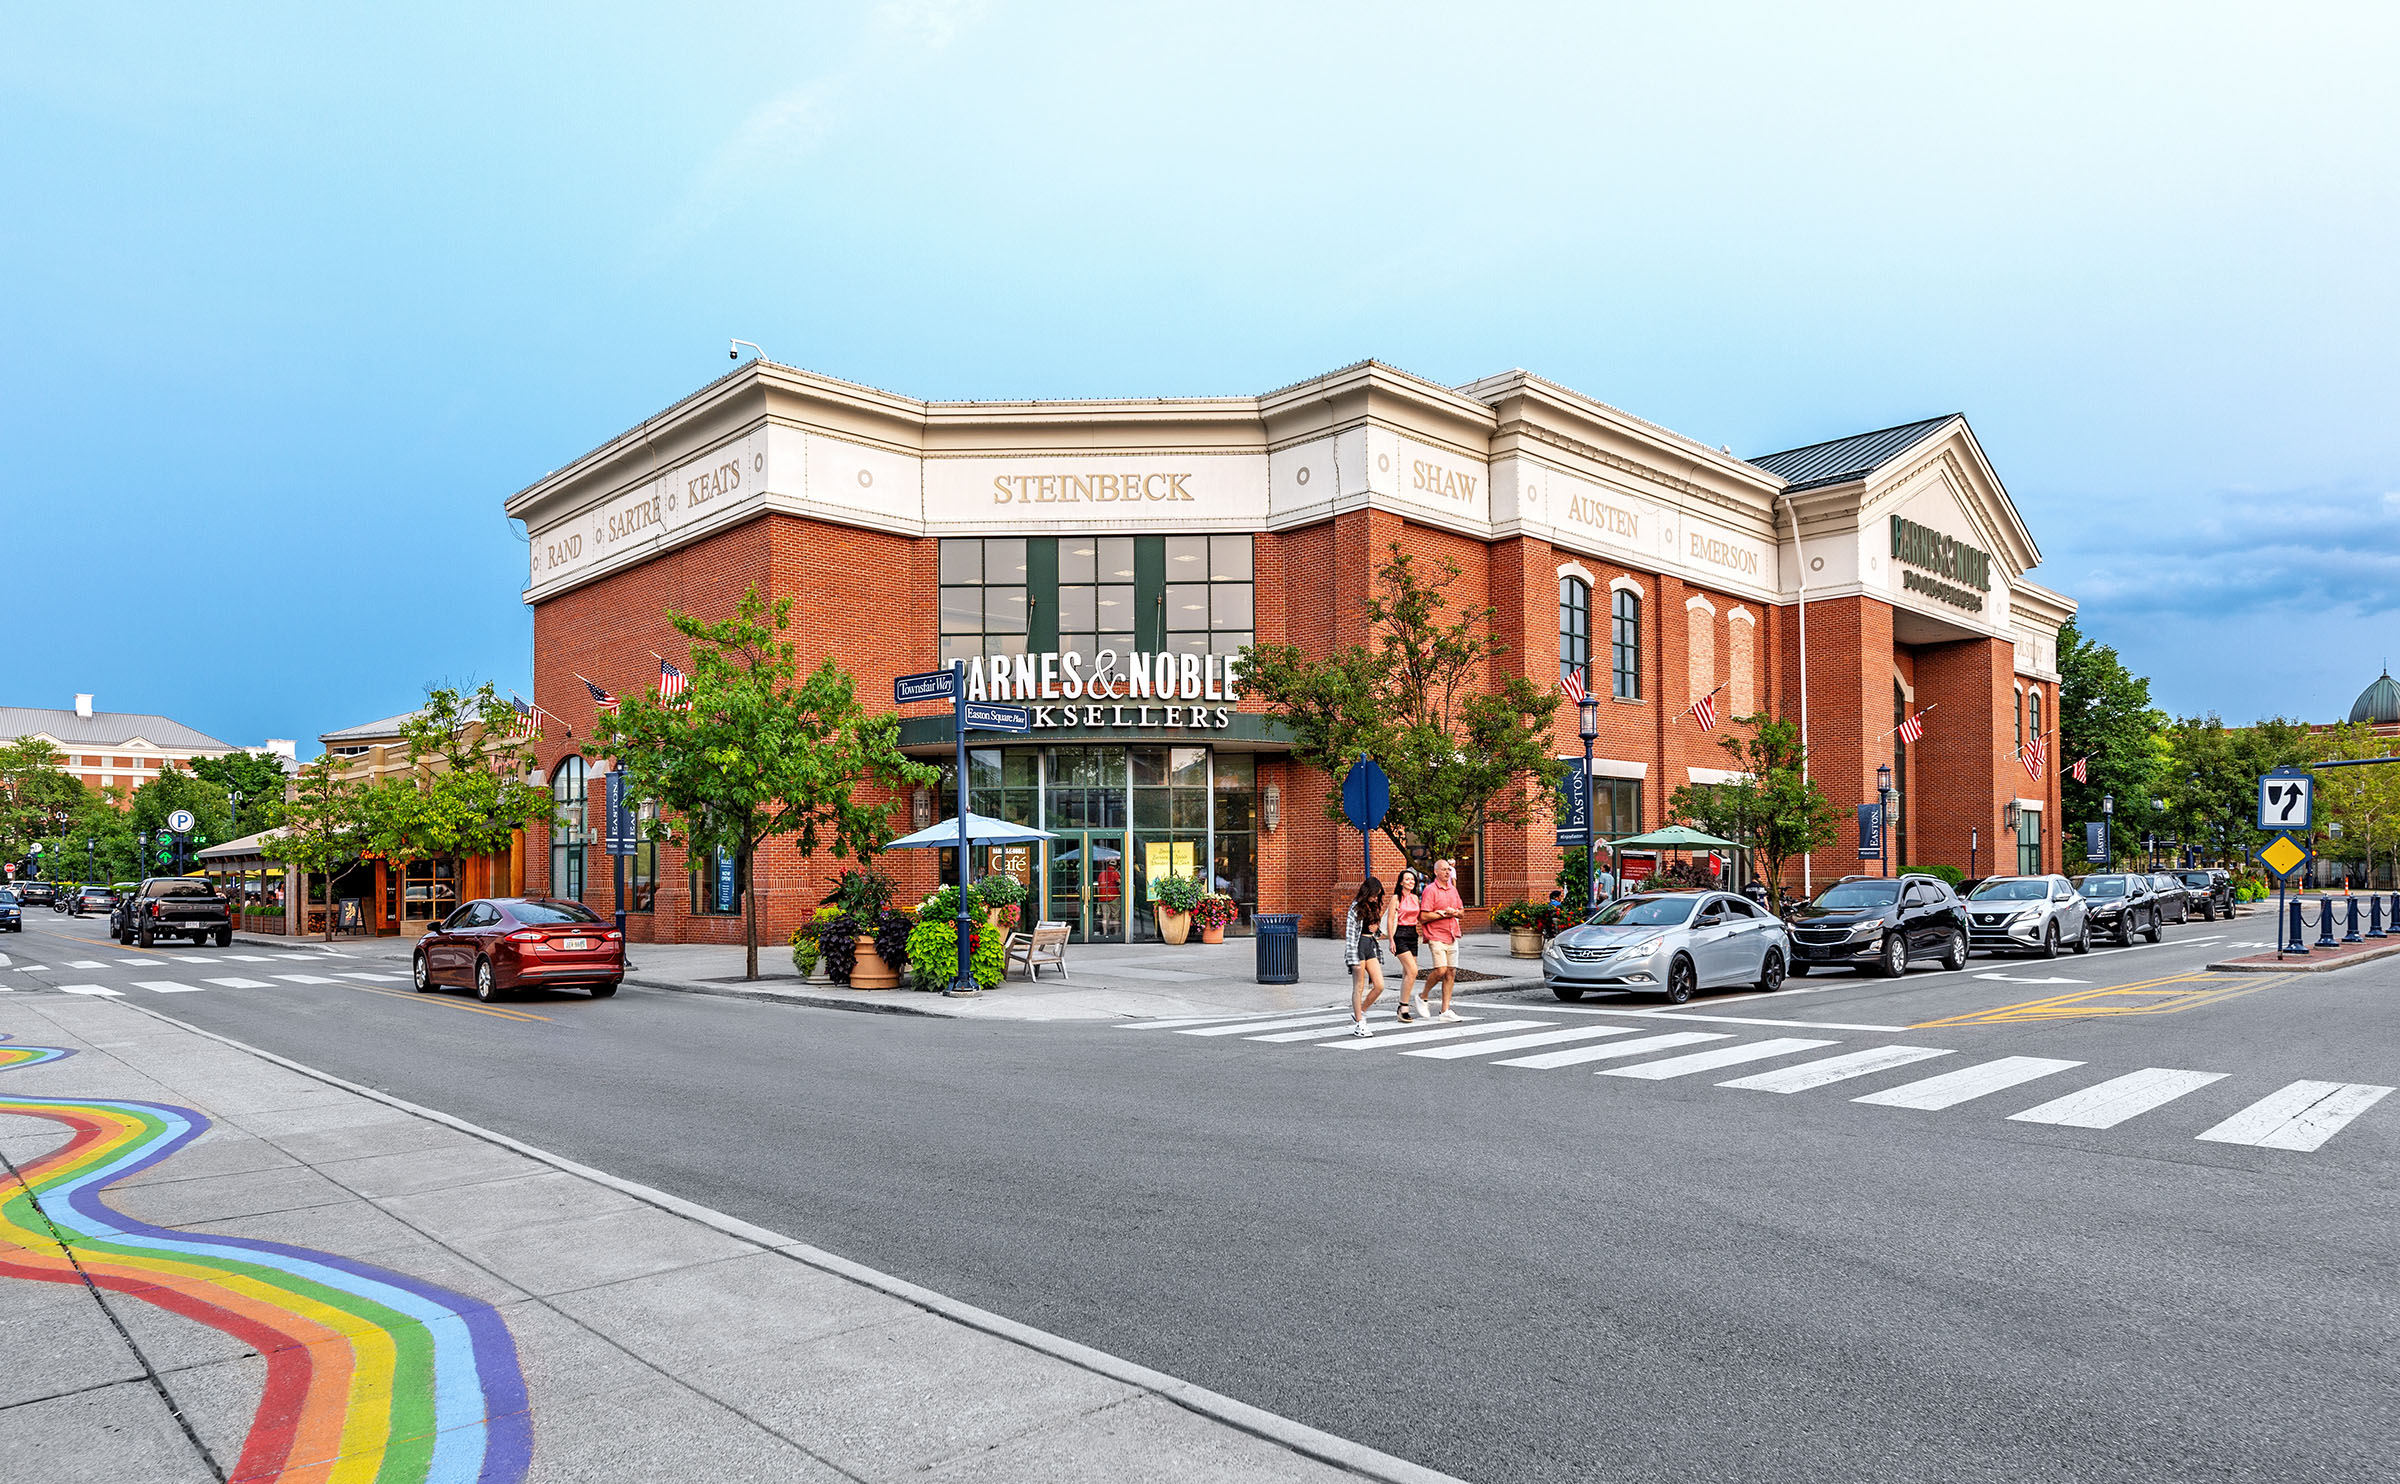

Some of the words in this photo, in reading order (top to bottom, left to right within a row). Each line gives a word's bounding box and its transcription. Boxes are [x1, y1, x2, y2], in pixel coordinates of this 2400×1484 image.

[687, 458, 741, 508] KEATS
[993, 473, 1195, 504] STEINBECK
[1413, 459, 1477, 503] SHAW
[608, 495, 661, 542] SARTRE
[1568, 494, 1639, 539] AUSTEN
[547, 533, 582, 569] RAND
[1690, 532, 1758, 575] EMERSON
[899, 680, 936, 696] Townsfair
[936, 677, 952, 691] Way
[1129, 651, 1240, 701] NOBLE
[967, 708, 990, 720] Easton
[991, 711, 1013, 724] Square
[1022, 704, 1229, 729] KSELLERS
[178, 815, 188, 828] P
[992, 855, 1026, 871] Café
